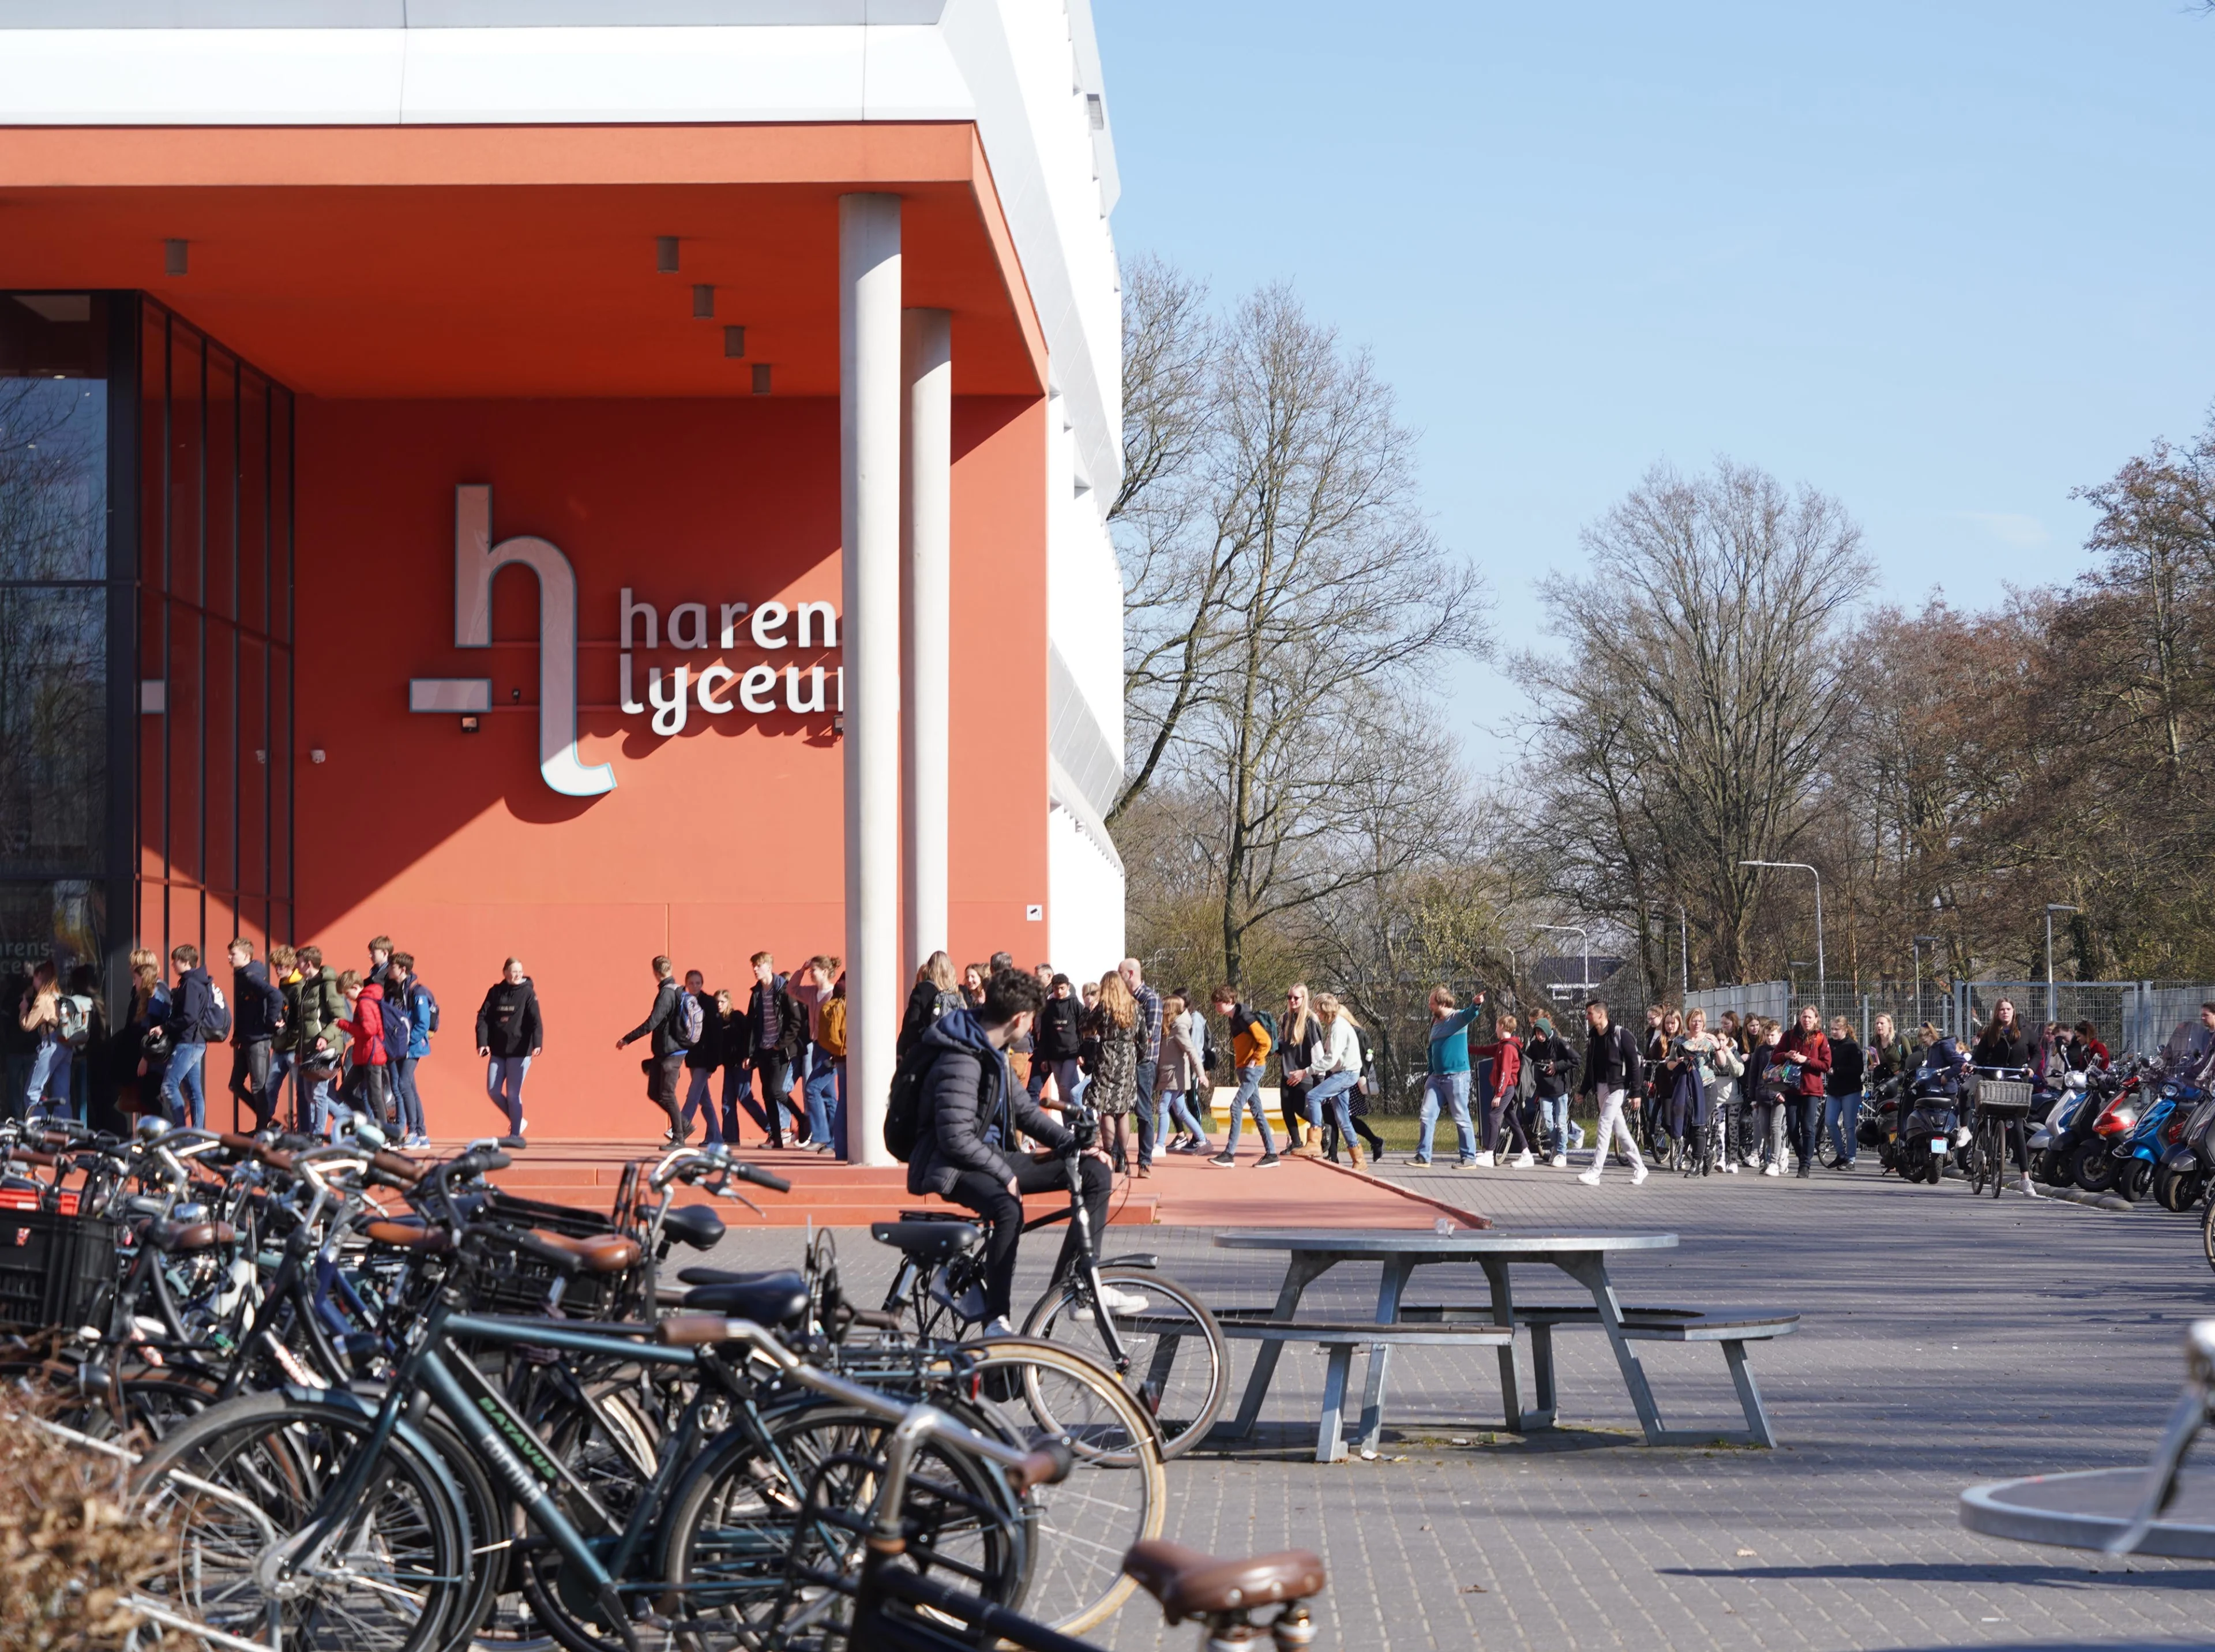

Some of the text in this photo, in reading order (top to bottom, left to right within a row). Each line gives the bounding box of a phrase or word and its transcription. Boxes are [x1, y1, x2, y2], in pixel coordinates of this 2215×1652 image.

[620, 652, 843, 736] lyceu
[0, 941, 50, 957] rens
[478, 1396, 557, 1479] BATAVUS
